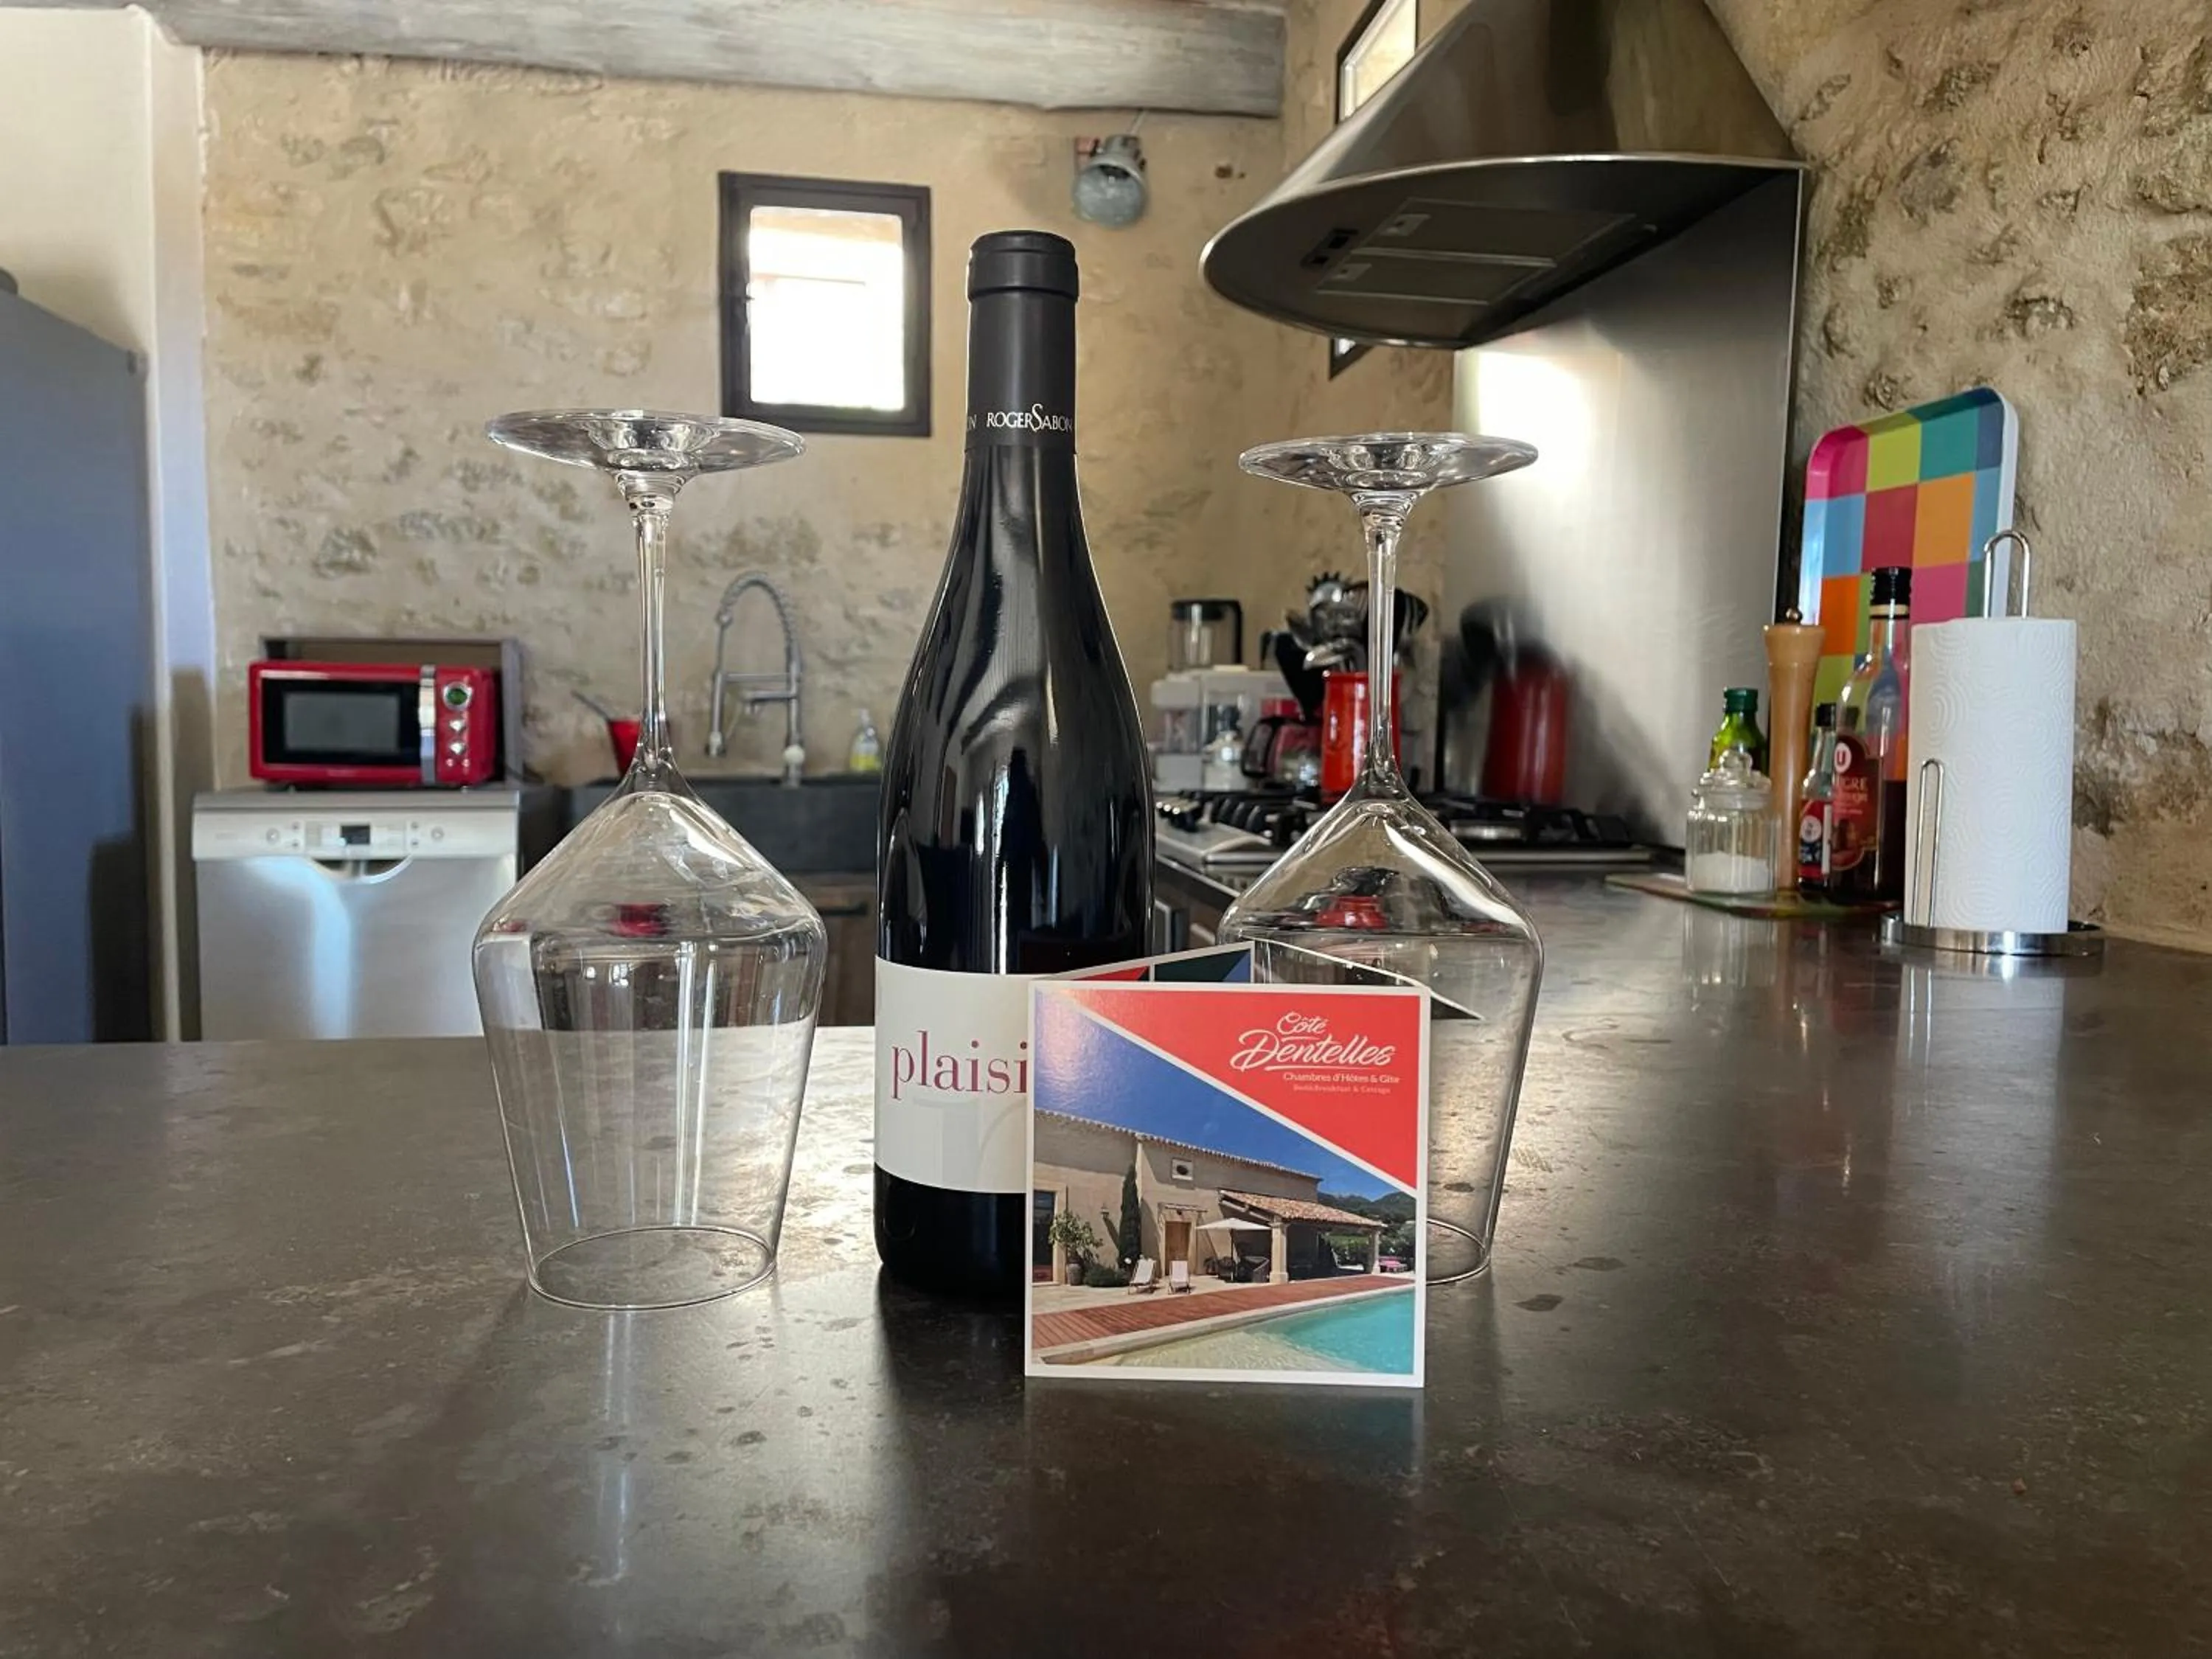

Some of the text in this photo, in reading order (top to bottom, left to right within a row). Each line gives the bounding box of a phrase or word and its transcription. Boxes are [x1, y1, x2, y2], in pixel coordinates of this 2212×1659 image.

[1276, 1011, 1329, 1035] Côté
[1229, 1029, 1397, 1071] Dentelles
[1283, 1072, 1332, 1082] Chambres
